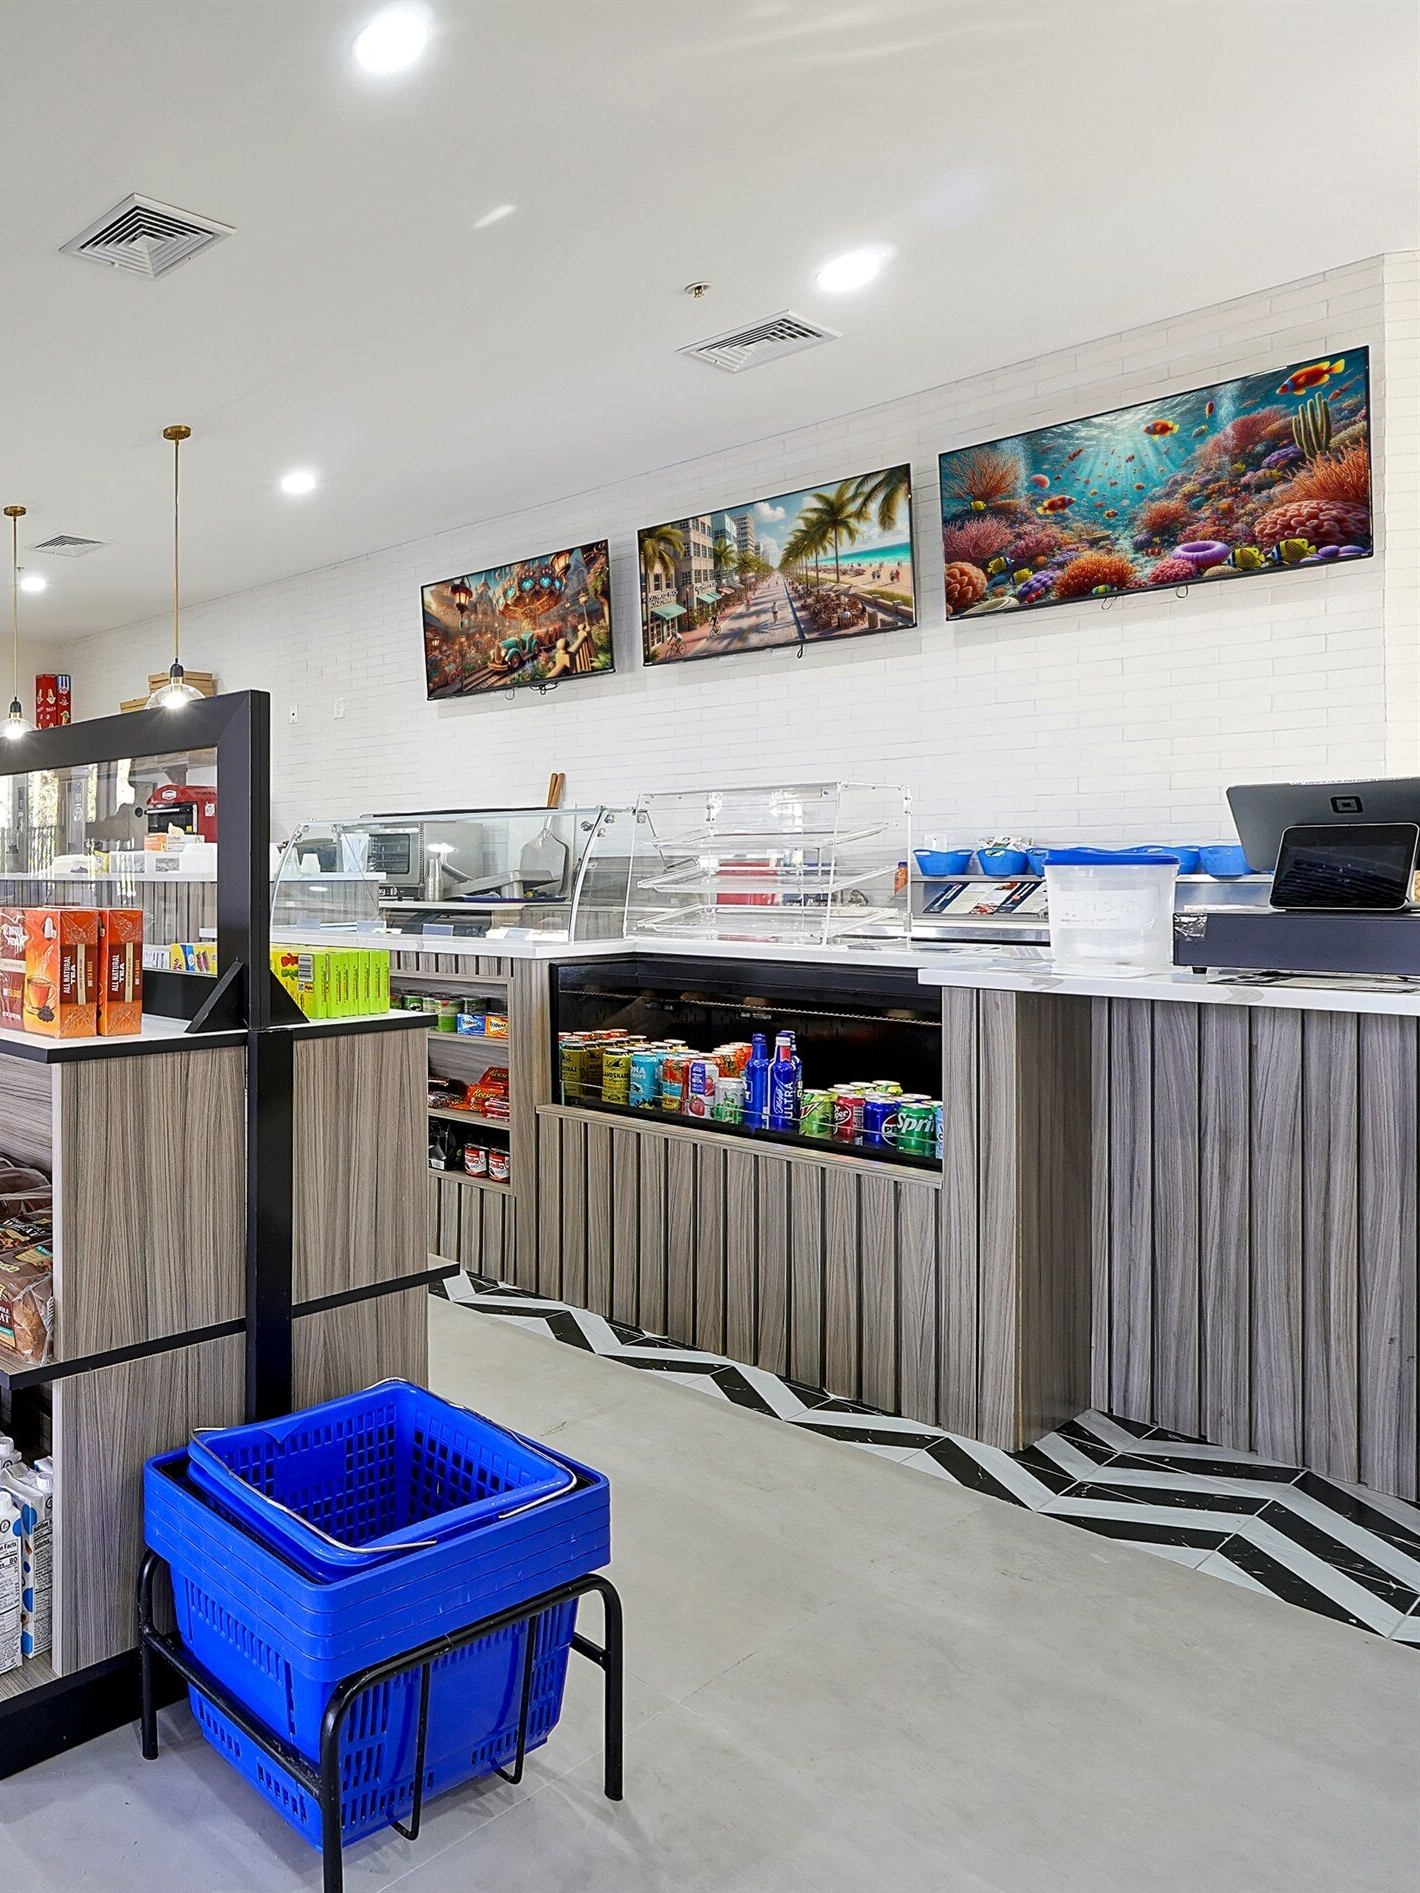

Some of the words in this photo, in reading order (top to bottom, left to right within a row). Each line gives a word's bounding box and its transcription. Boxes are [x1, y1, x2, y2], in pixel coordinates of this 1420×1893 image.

[63, 955, 71, 984] NATURAL
[111, 954, 120, 981] NATURAL
[63, 984, 71, 994] ALL
[111, 981, 119, 992] ALL
[784, 1081, 794, 1119] ULTRA
[897, 1112, 935, 1134] Spri
[4, 1541, 17, 1550] Facts
